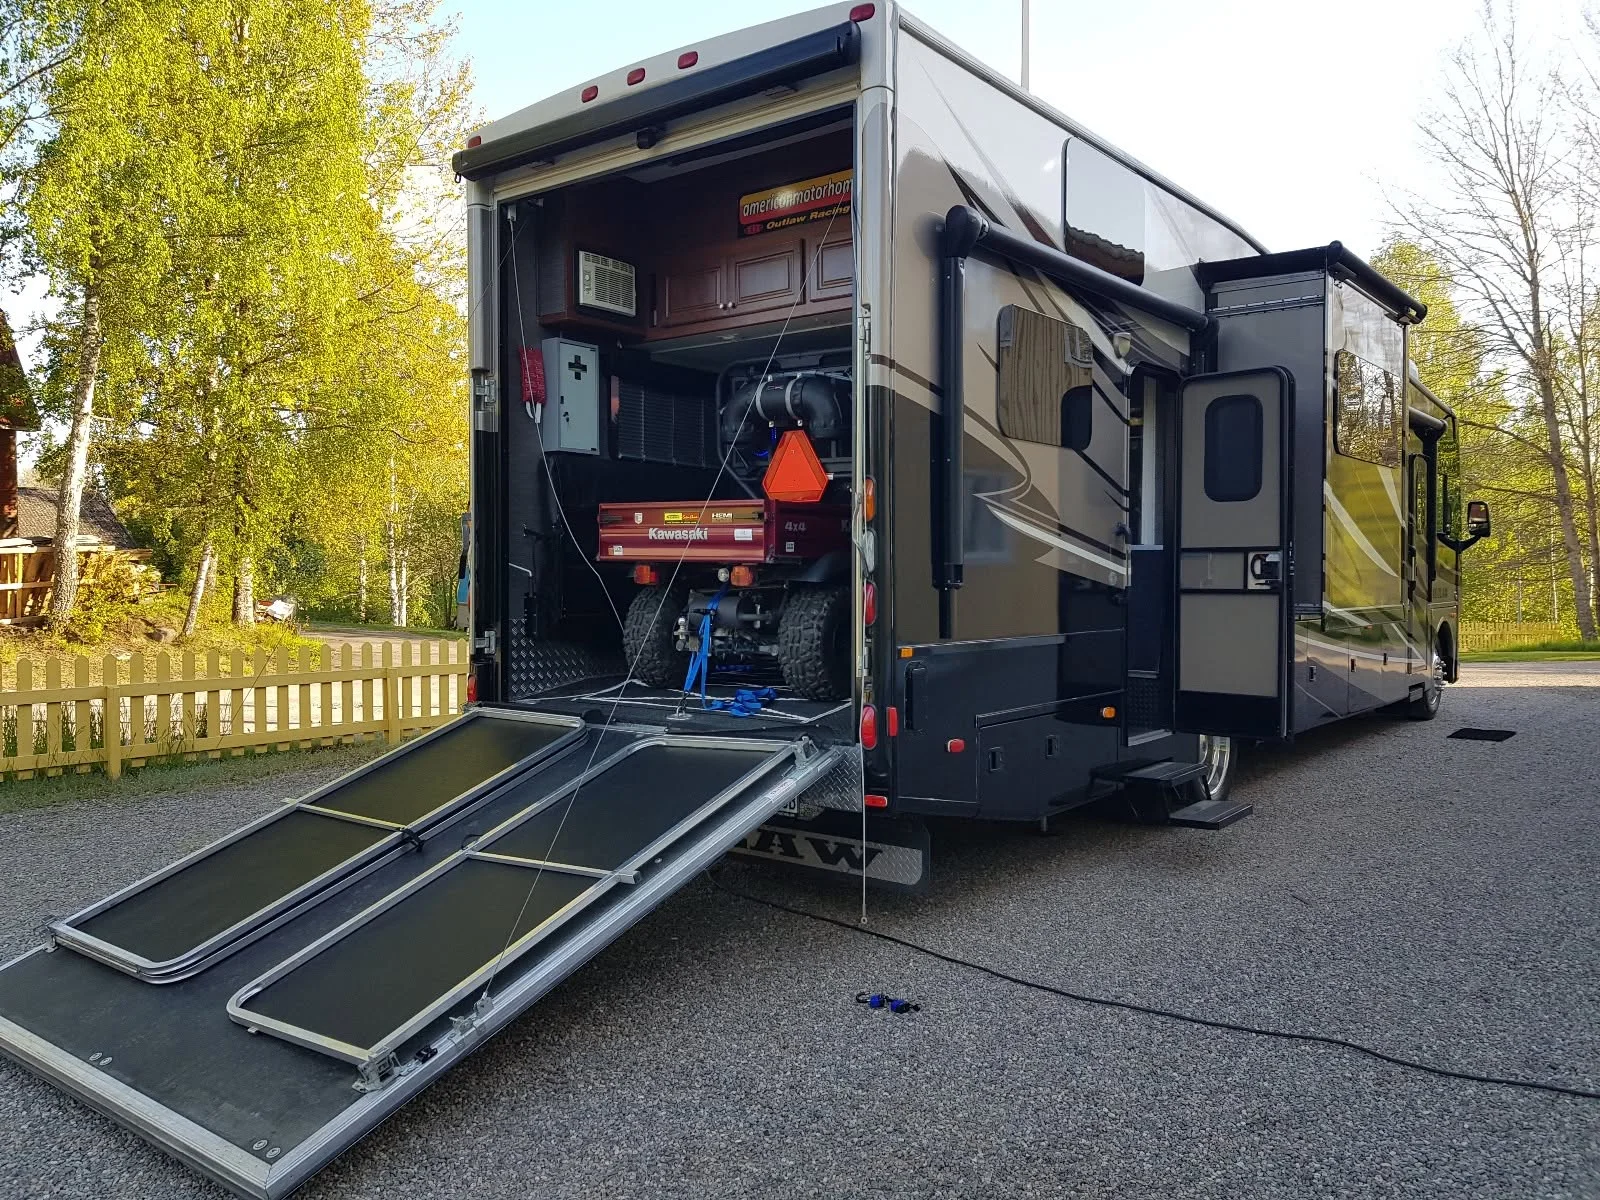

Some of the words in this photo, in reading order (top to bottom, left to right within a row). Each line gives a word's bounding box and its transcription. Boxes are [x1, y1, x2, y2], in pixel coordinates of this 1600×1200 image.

[766, 215, 807, 230] Outlaw
[809, 205, 851, 220] Racing
[784, 521, 807, 532] 4x4
[648, 527, 709, 540] Kawasaki
